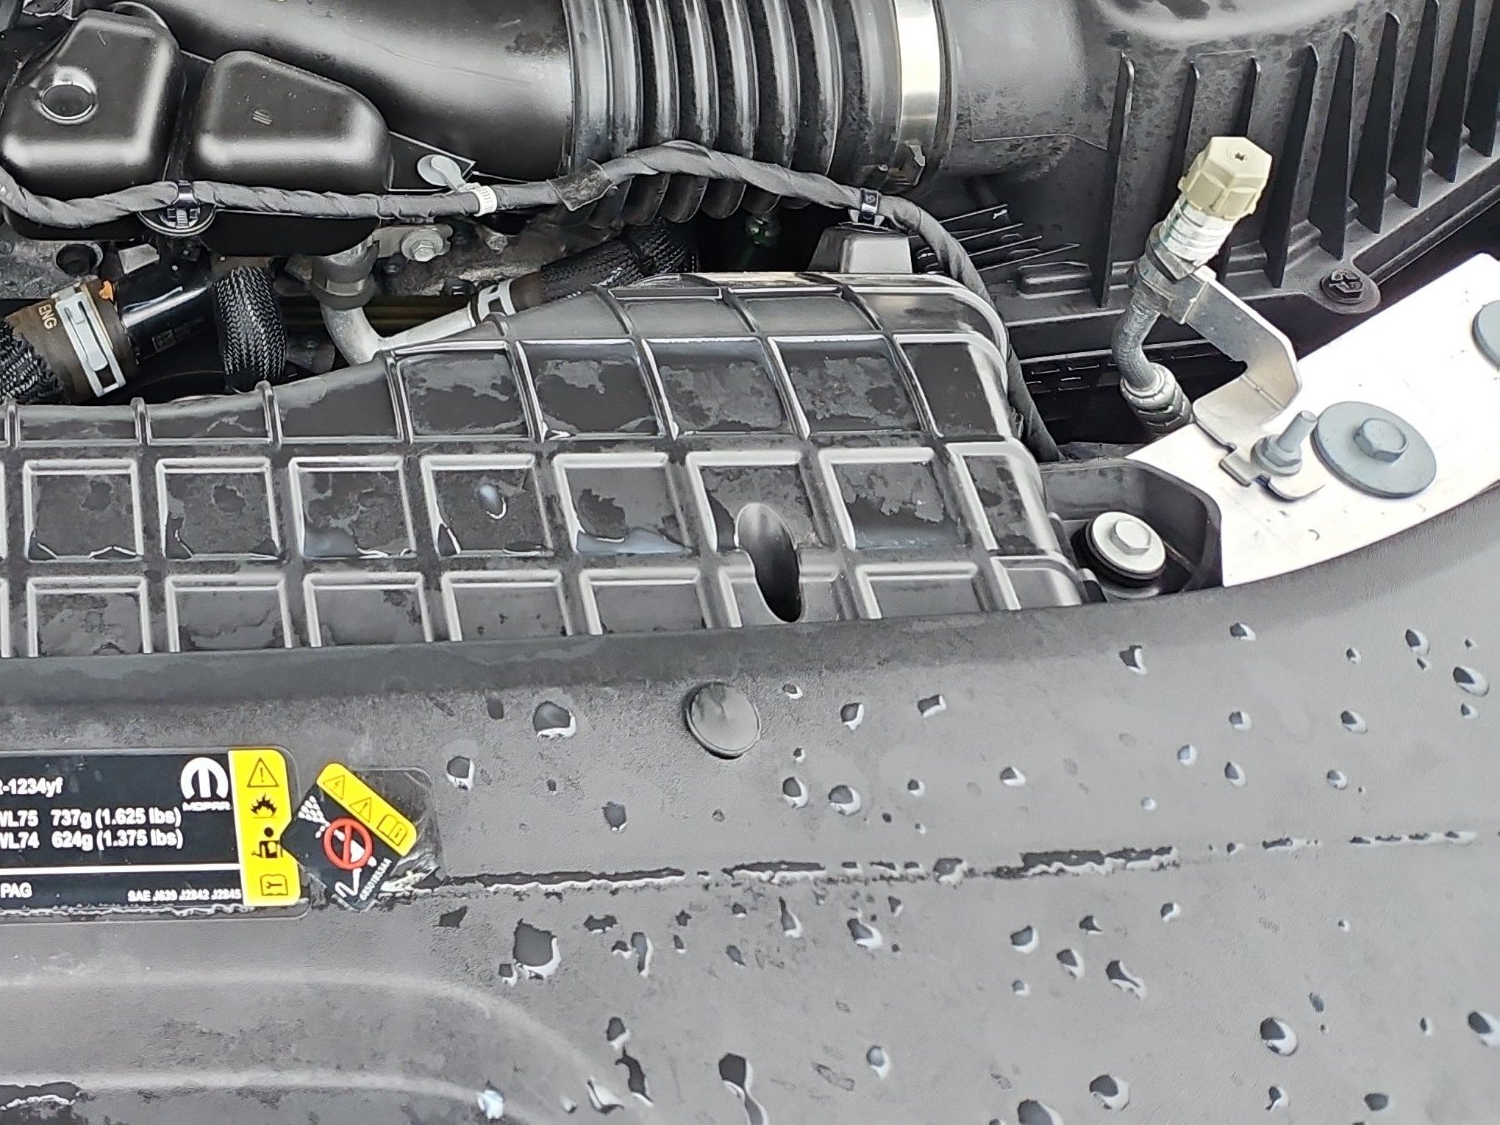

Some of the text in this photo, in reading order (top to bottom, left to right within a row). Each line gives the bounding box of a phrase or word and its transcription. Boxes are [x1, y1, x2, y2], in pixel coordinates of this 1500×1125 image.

[38, 304, 57, 330] ENG
[50, 808, 93, 831] 737g
[94, 807, 147, 830] (1.625
[150, 806, 183, 829] lbs)
[51, 829, 94, 852] 624g
[96, 828, 148, 851] (1.375
[150, 828, 184, 850] lbs)
[0, 881, 33, 899] PAG
[127, 889, 152, 902] SAE
